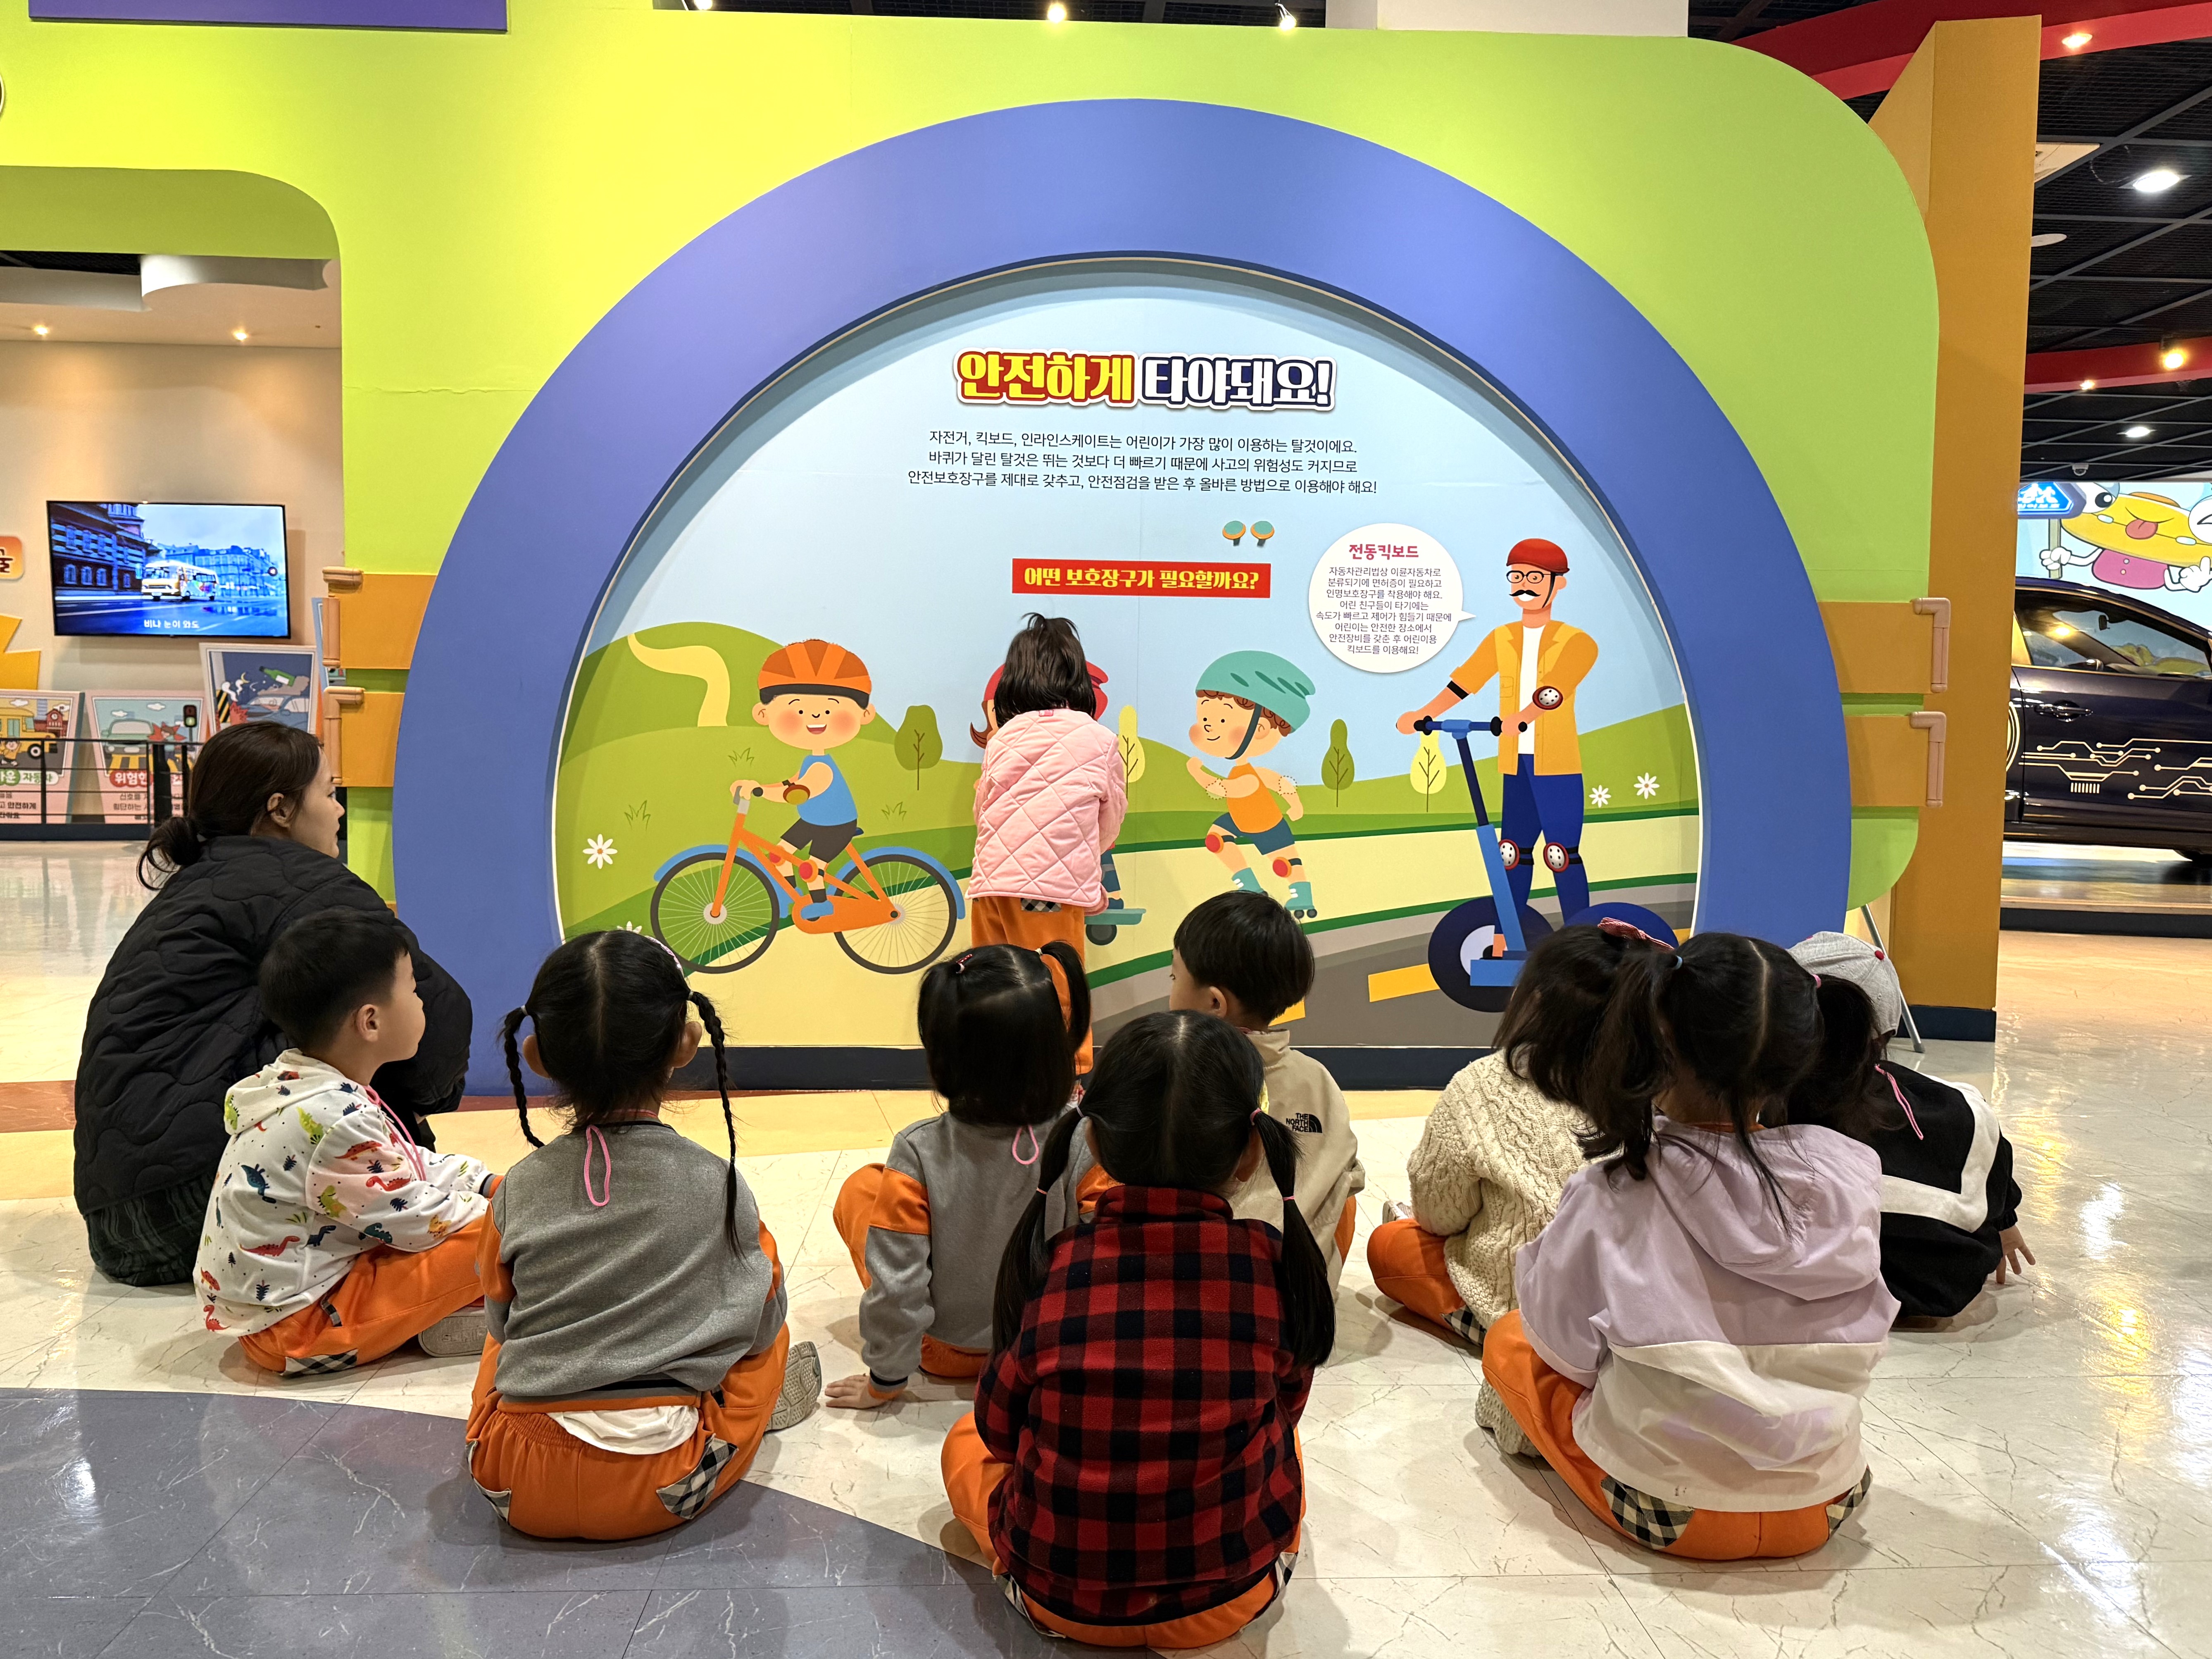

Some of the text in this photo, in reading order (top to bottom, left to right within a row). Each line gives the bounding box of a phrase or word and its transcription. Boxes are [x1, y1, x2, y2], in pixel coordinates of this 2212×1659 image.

[958, 352, 1332, 408] 안전하게 타야돼요!
[930, 431, 1357, 453] 자전거, 킥보드, 인라인스케이트는 어린이가 가장 많이 이용하는 탈것이에요.
[929, 451, 1357, 473] 바퀴가 달린 탈것은 뛰는 것보다 더 빠르기 때문에 사고의 위험성도 커지므로
[908, 471, 1376, 494] 안전보호장구를 제대로 갖추고, 안전점검을 받은 후 올바른 방법으로 이용해야 해요!
[1349, 544, 1419, 560] 전동킥보드
[1329, 567, 1441, 577] 자동차관리법상 이륜자동차로
[1024, 567, 1259, 589] 어떤 보호장구가 필요할까요?
[1328, 578, 1442, 588] 분류되기에 면허증이 필요하고
[1326, 589, 1443, 599] 인명보호장구를 착용해야 해요.
[1340, 601, 1429, 610] 어린 친구들이 타기에는
[1316, 611, 1452, 622] 속도가 빠르고 제어가 힘들기 때문에
[1335, 622, 1432, 633] 어린이는 안전한 장소에서
[1329, 634, 1437, 644] 안전장비를 갖춘 후 어린이용
[1348, 645, 1419, 655] 킥보드를 이용해요!
[1286, 1118, 1309, 1127] NORTH
